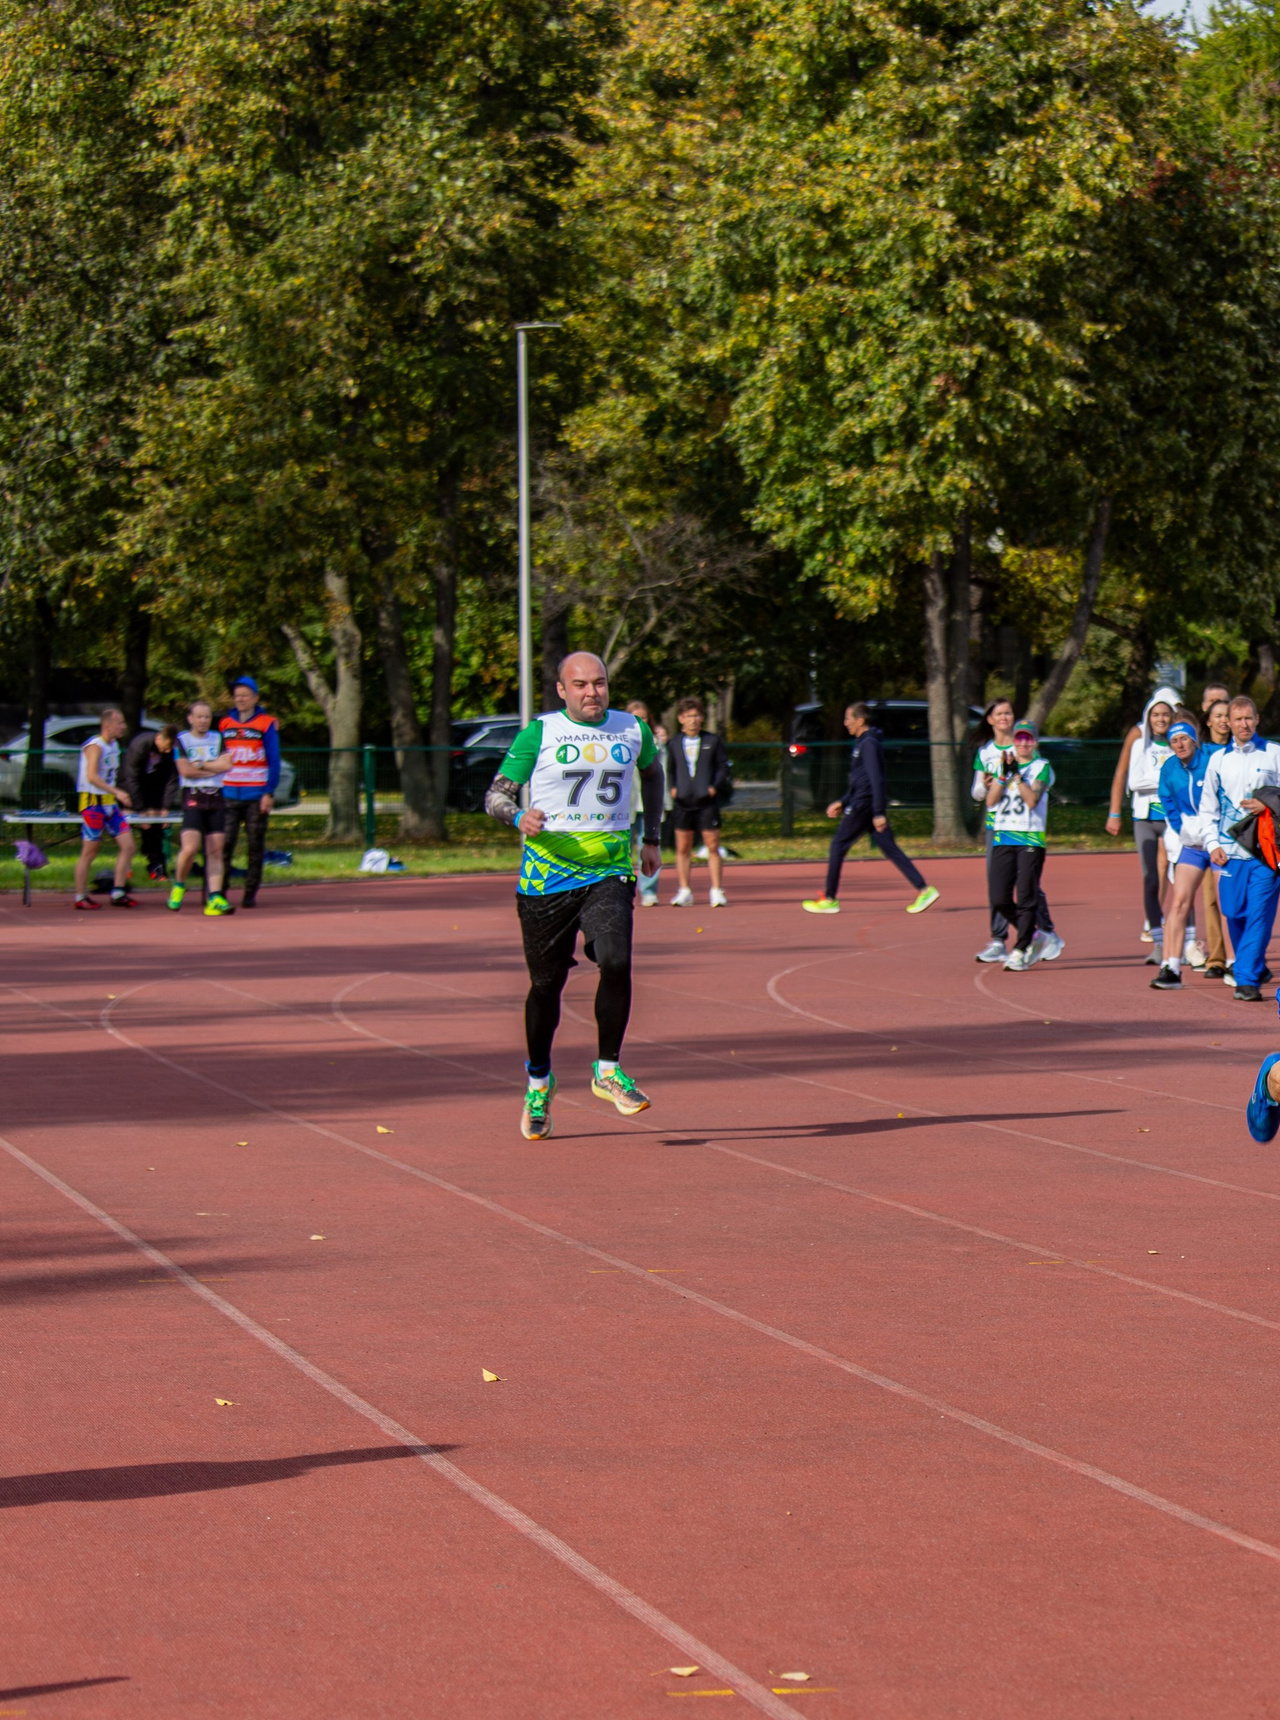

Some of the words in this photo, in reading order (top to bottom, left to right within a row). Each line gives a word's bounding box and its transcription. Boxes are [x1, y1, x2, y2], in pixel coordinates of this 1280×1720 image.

[555, 733, 630, 743] VMARAFONE
[562, 769, 625, 807] 75
[1001, 795, 1026, 816] 23
